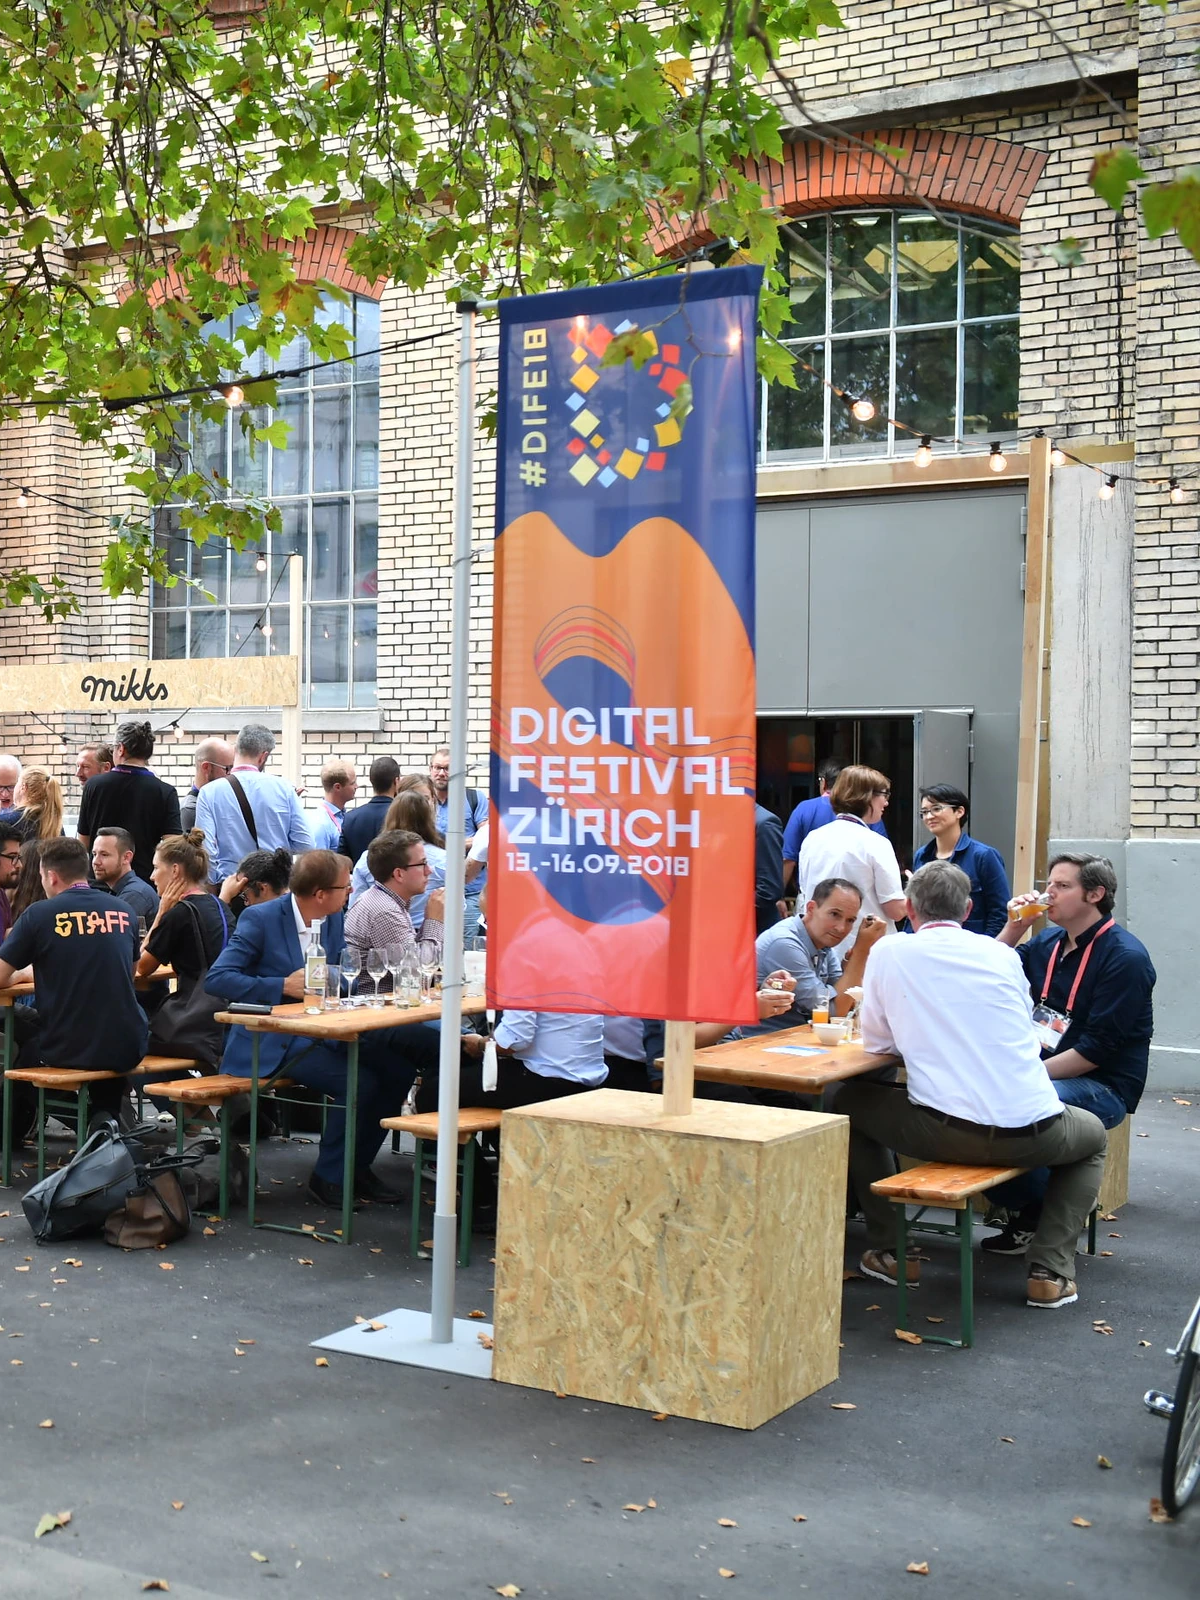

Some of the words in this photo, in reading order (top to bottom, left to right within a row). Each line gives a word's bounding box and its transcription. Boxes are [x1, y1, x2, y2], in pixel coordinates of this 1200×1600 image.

[519, 328, 548, 488] #DIFE18
[80, 667, 169, 702] mikks
[510, 706, 711, 746] DIGITAL
[509, 755, 746, 796] FESTIVAL
[507, 796, 700, 848] ZÜRICH
[506, 852, 690, 877] 13.-16.09.2018
[54, 910, 130, 937] STAFF
